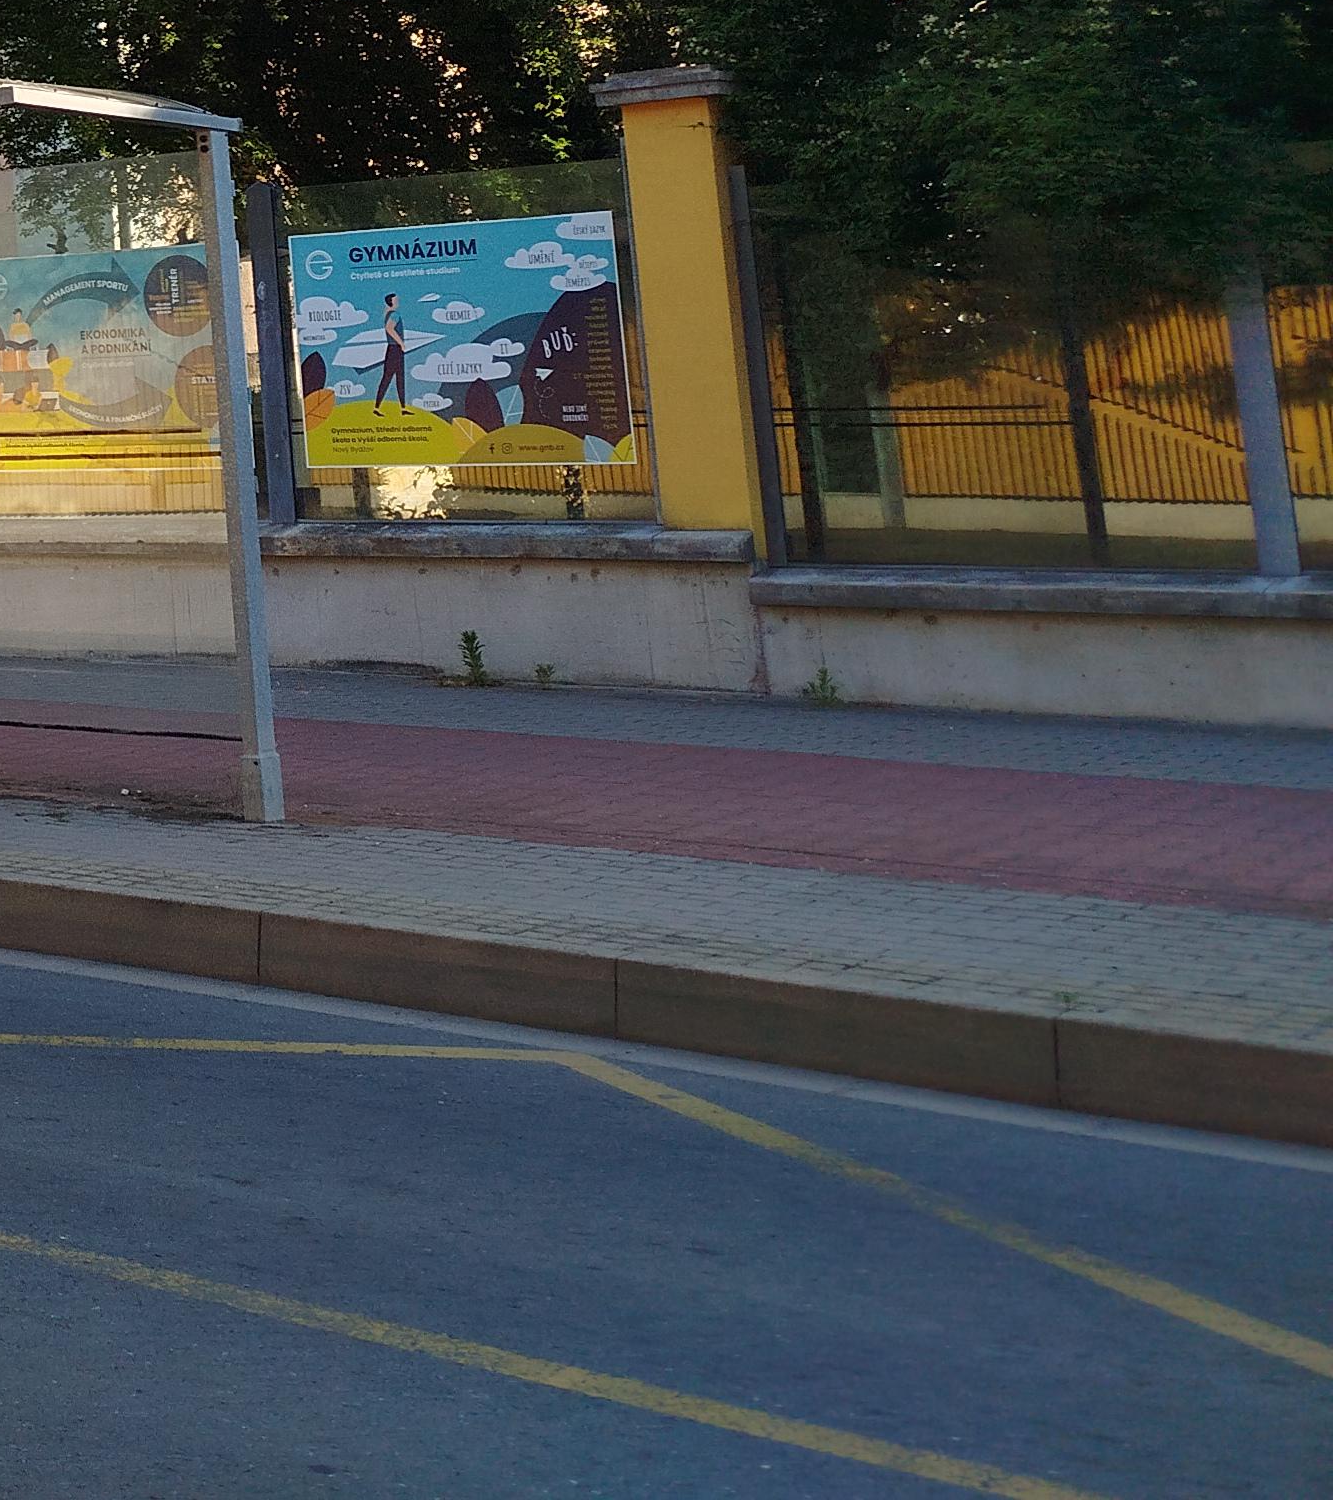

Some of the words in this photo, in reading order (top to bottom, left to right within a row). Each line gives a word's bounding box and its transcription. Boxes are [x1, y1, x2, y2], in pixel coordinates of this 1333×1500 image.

[349, 238, 477, 263] GYMNÁZIUM
[528, 250, 555, 264] UMĚNÍ
[426, 266, 461, 275] studium
[168, 268, 180, 304] TRENÉR
[565, 275, 590, 287] ZEMĚPIS
[43, 280, 96, 306] MANAGEMENT
[97, 280, 129, 292] SPORTU
[308, 310, 342, 322] BIOLOGIE
[445, 310, 471, 321] CHEMIE
[80, 327, 146, 340] EKONOMIKA
[81, 345, 89, 354] A
[91, 339, 151, 354] PODNIKÁNÍ
[499, 342, 509, 355] IT
[437, 362, 454, 375] CIZÍ
[455, 361, 483, 375] JAZYKY
[339, 384, 352, 395] ZSV
[377, 435, 406, 443] odborná
